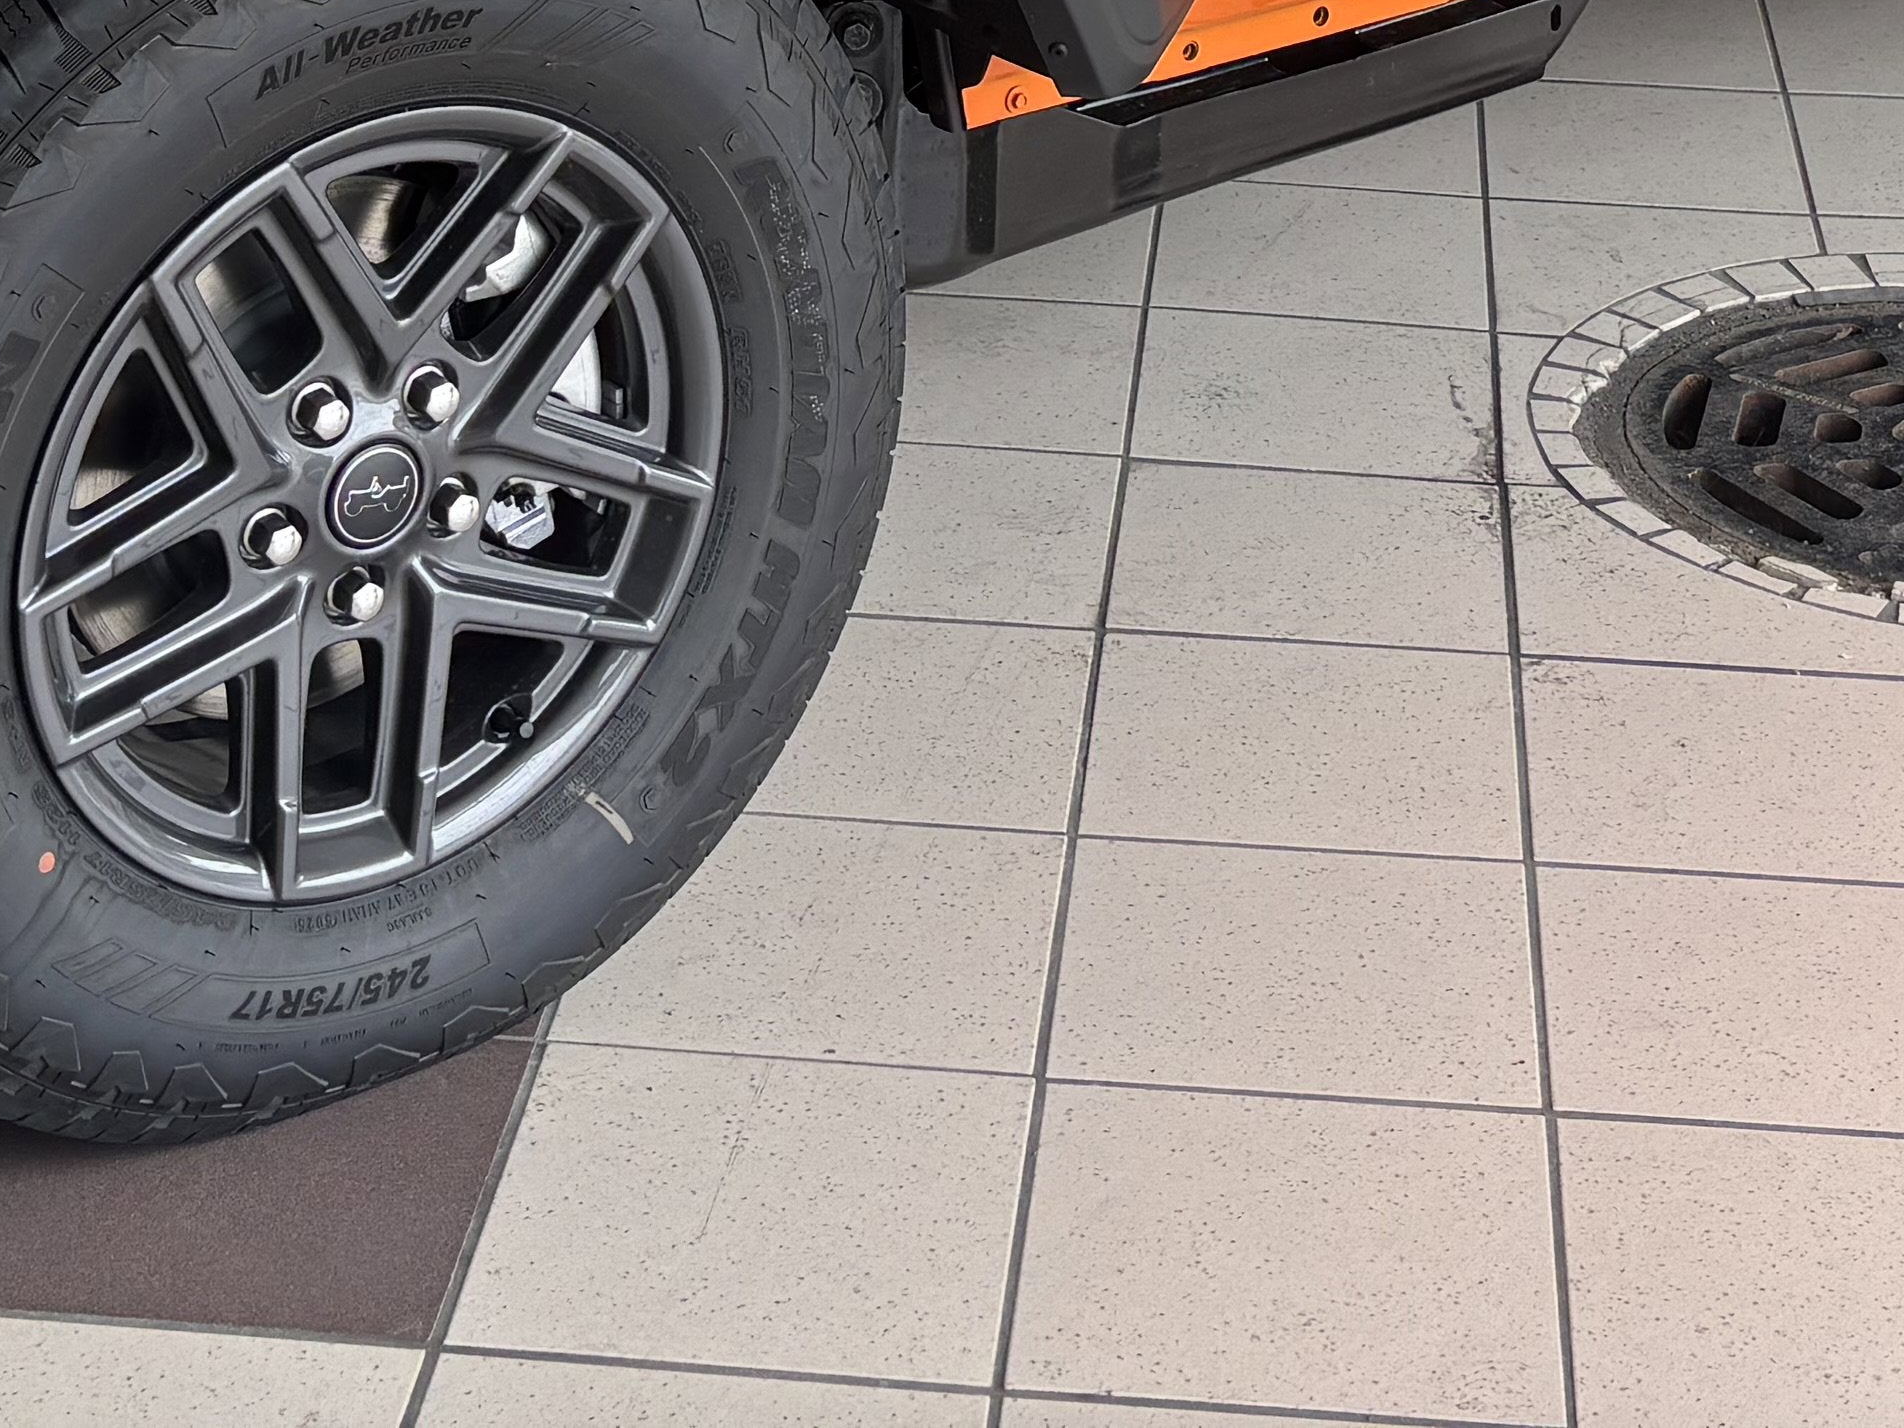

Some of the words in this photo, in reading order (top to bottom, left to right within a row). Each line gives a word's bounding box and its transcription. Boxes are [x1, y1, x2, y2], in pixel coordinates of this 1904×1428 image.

[254, 6, 483, 100] All-Weather
[345, 35, 472, 74] Performance
[228, 954, 432, 1020] 245/75R17
